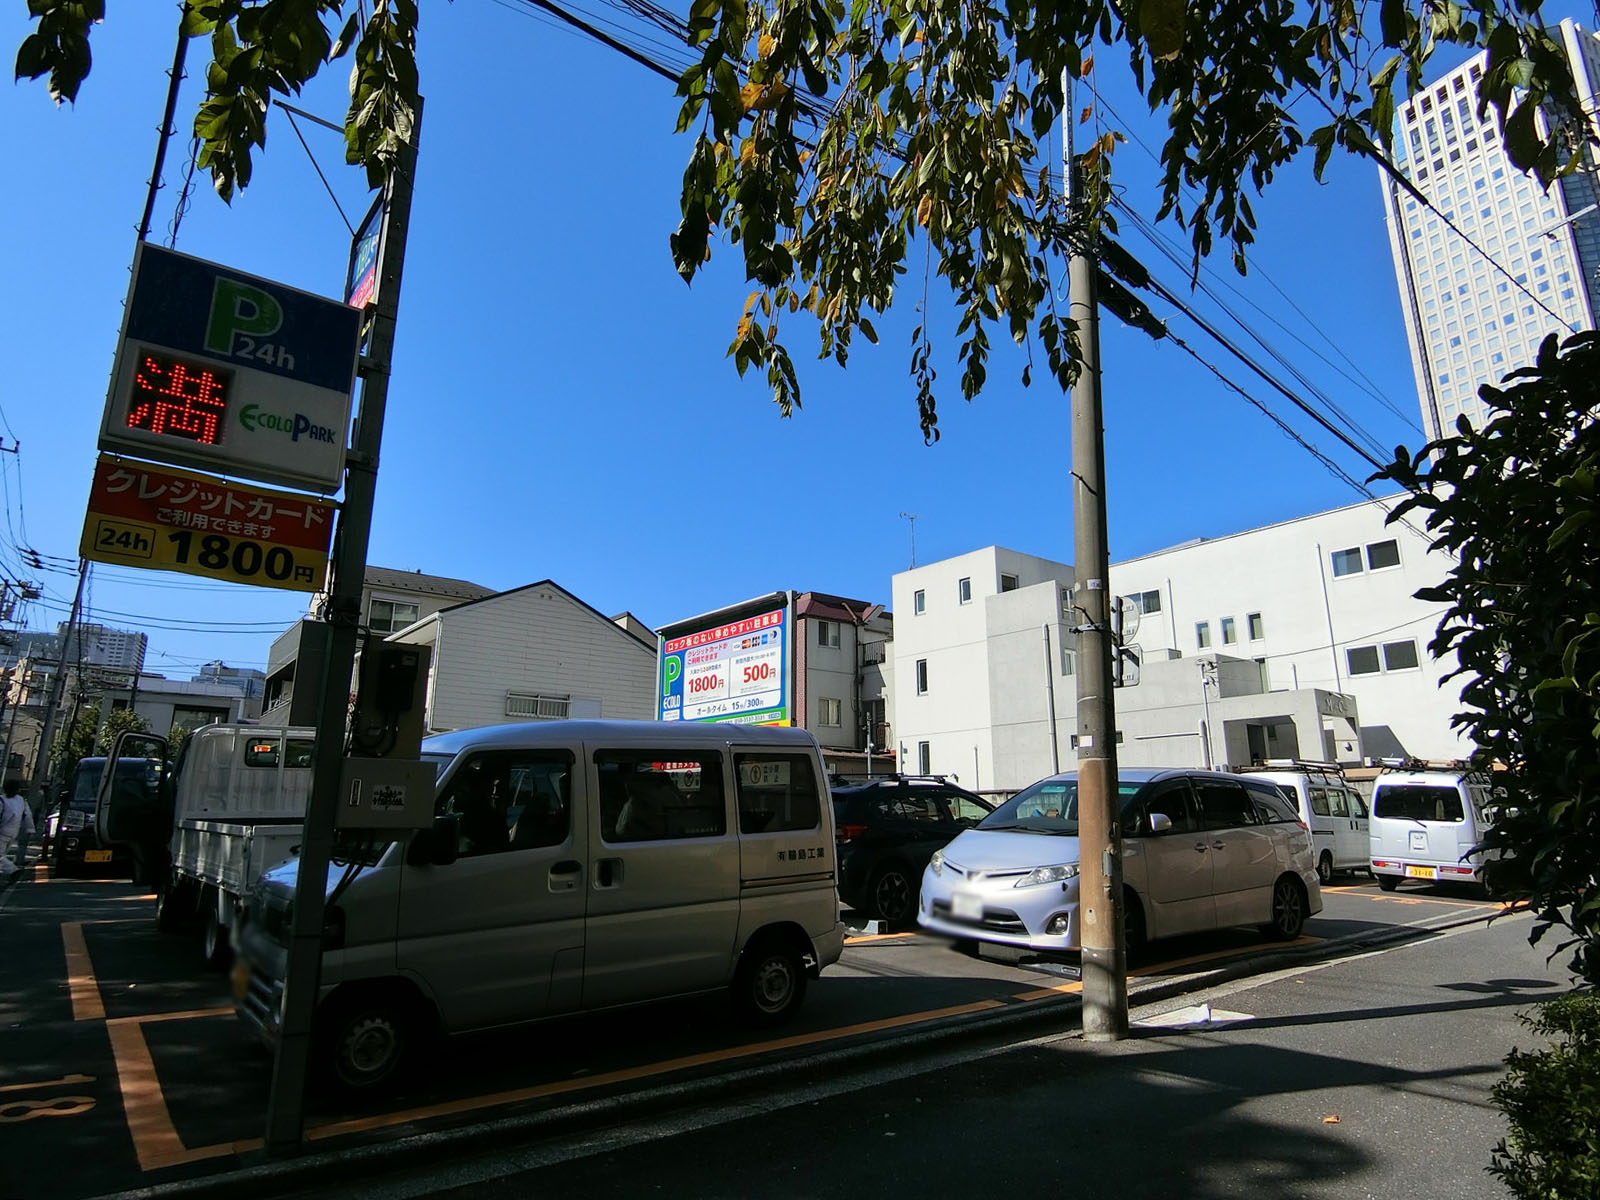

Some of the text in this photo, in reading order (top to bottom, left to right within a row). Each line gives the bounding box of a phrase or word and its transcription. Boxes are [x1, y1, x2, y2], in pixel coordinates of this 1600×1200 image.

[203, 276, 284, 357] P
[236, 336, 295, 372] 24h
[127, 358, 225, 444] 満
[106, 469, 325, 530] クレジットカード
[100, 528, 149, 552] 24h
[156, 507, 276, 539] ご利用できます
[168, 530, 314, 584] 1800円
[664, 655, 681, 697] P
[688, 674, 724, 694] 1800円
[743, 662, 777, 684] 500円
